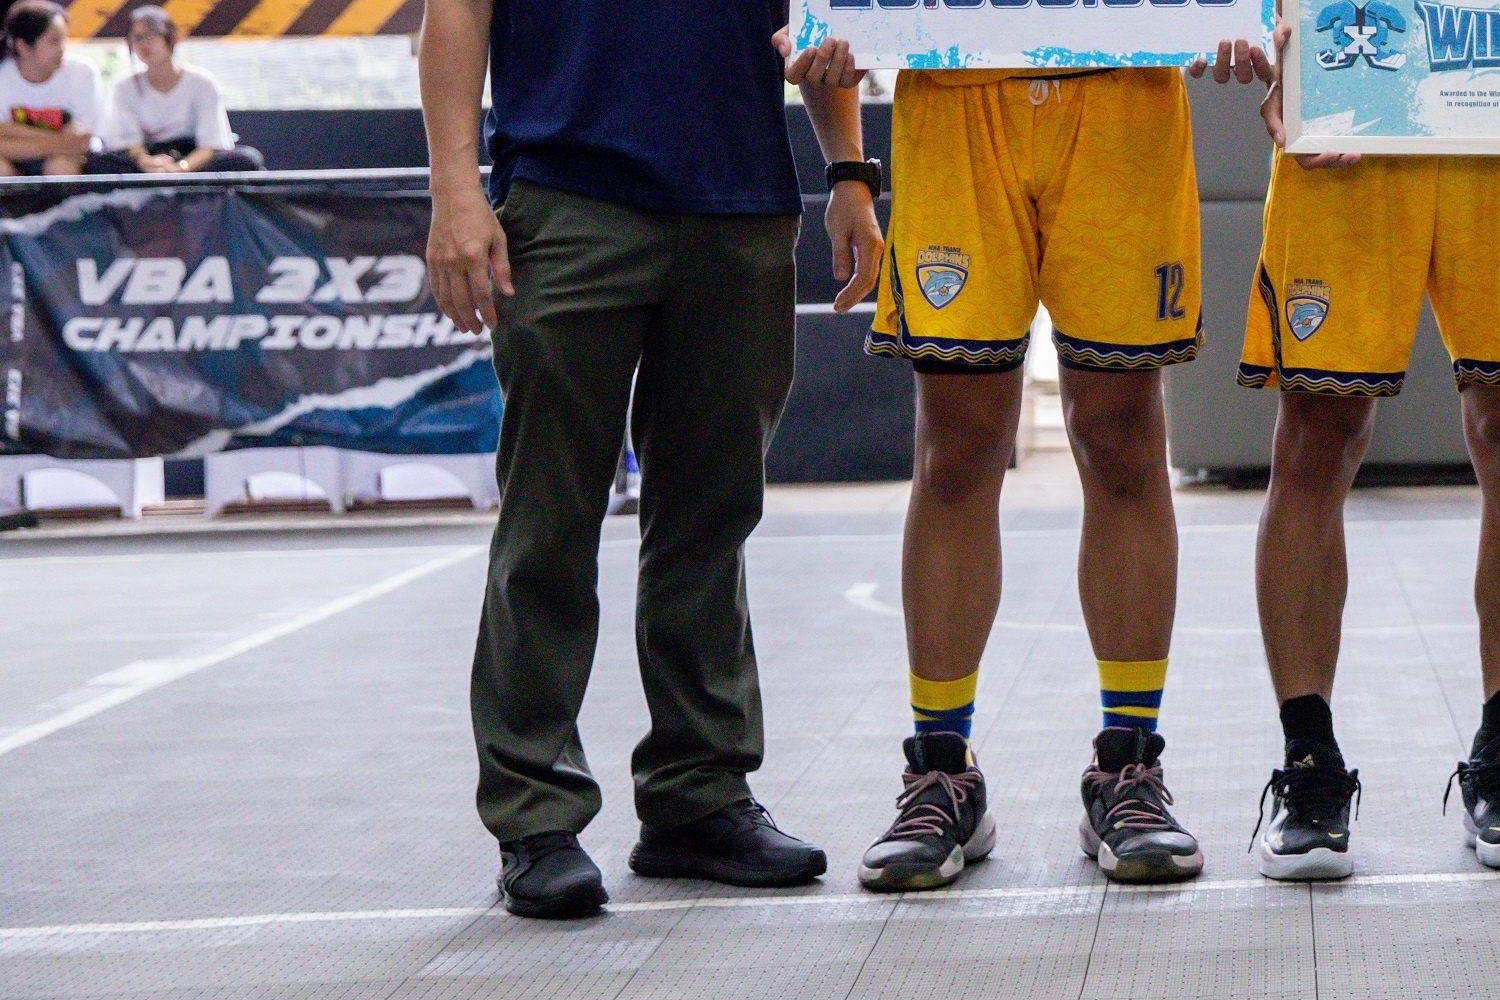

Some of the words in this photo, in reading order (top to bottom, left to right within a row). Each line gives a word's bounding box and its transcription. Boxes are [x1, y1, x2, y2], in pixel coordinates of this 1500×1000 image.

[76, 256, 234, 306] VBA
[255, 254, 427, 303] 3X3
[917, 249, 970, 269] DOLPHINS
[1154, 261, 1186, 321] 12
[63, 313, 491, 352] CHAMPIONSH
